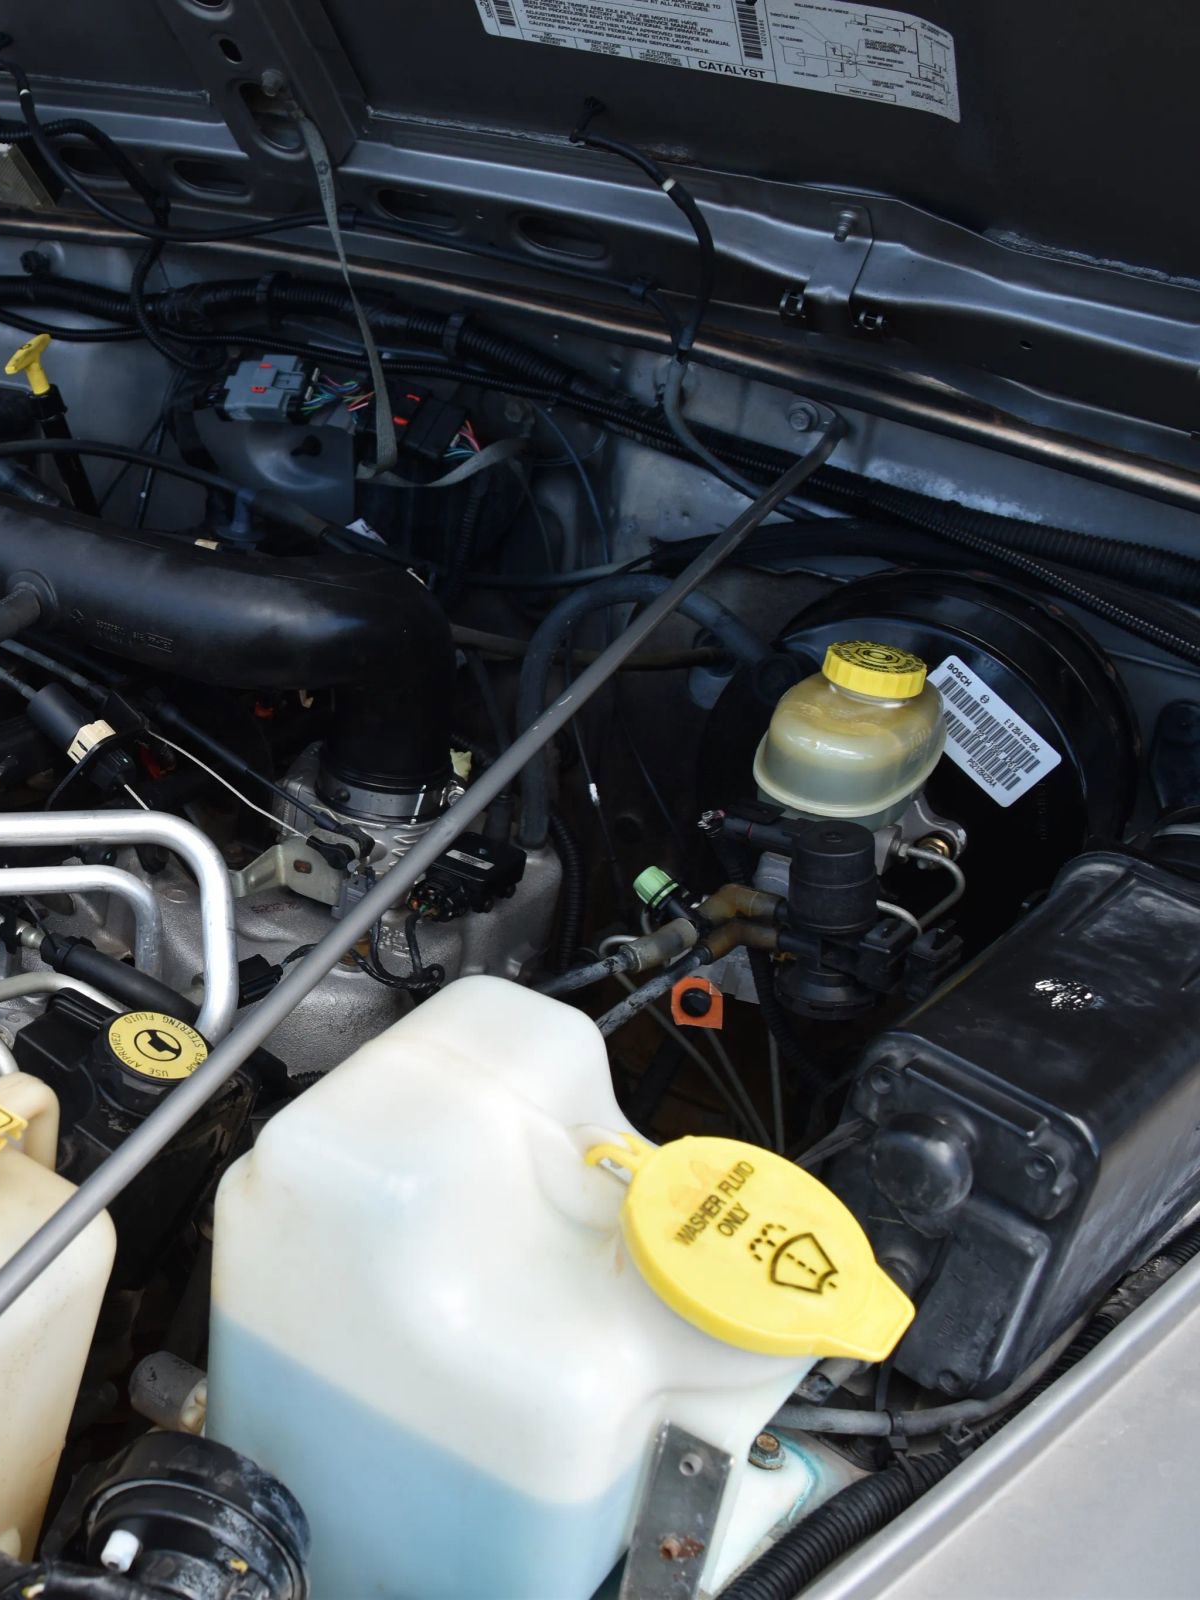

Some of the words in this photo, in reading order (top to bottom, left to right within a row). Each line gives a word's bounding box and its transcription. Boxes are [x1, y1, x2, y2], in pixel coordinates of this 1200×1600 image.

[698, 60, 766, 79] CATALYST
[946, 663, 972, 687] BOSCH
[124, 1013, 155, 1024] FLUID
[162, 1015, 204, 1048] STEERING
[111, 1032, 141, 1068] APPROVED
[149, 1067, 169, 1077] USE
[674, 1194, 727, 1246] WASHER
[718, 1160, 755, 1198] FLUID
[717, 1201, 750, 1237] ONLY
